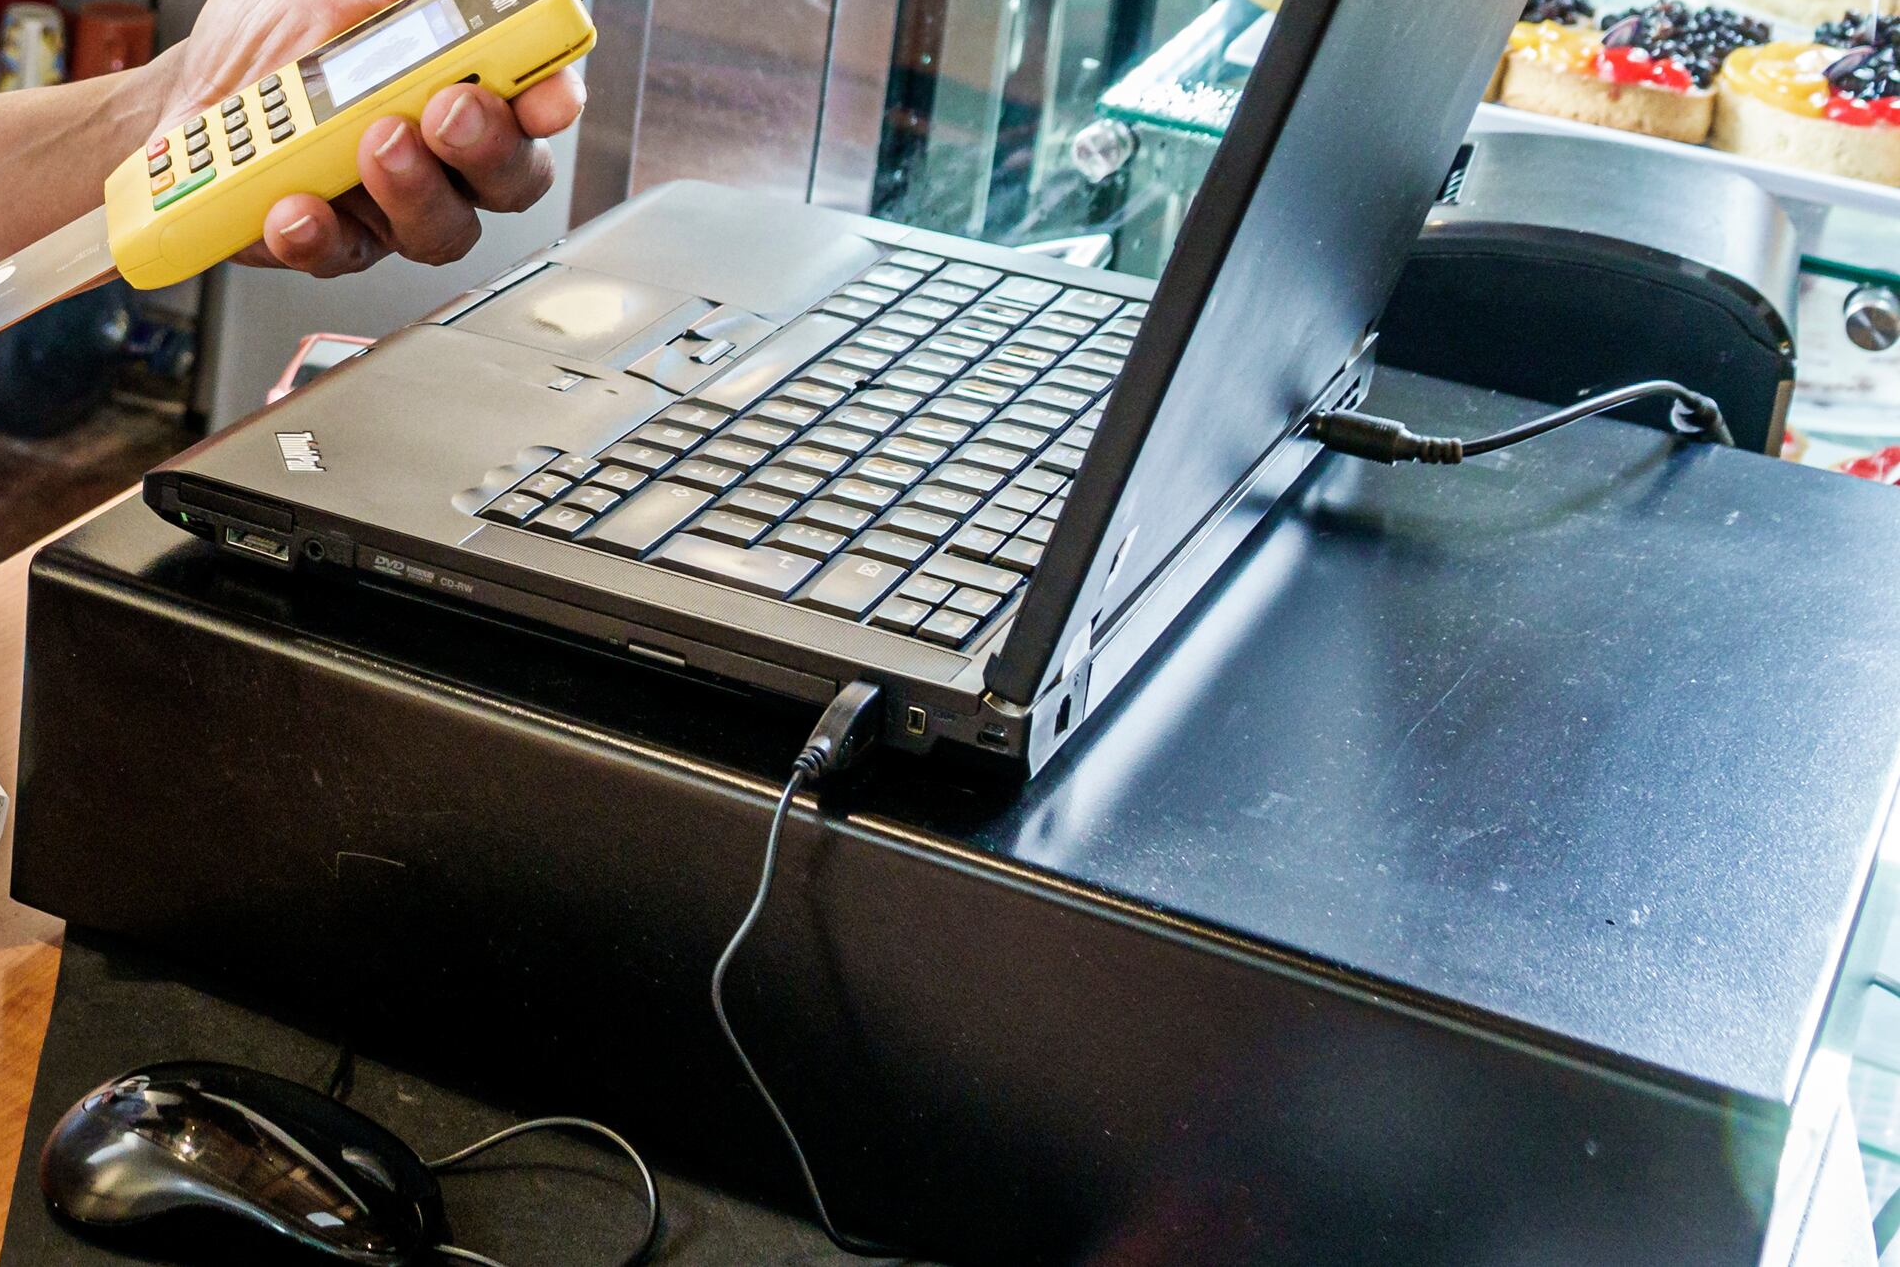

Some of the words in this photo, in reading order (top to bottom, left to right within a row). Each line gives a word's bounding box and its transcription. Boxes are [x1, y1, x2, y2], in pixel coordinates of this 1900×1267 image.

[841, 370, 860, 379] B
[916, 377, 933, 385] G
[893, 394, 912, 402] H
[848, 432, 864, 442] K
[870, 486, 887, 495] P
[374, 555, 405, 571] DVD
[440, 577, 474, 593] CD-RW
